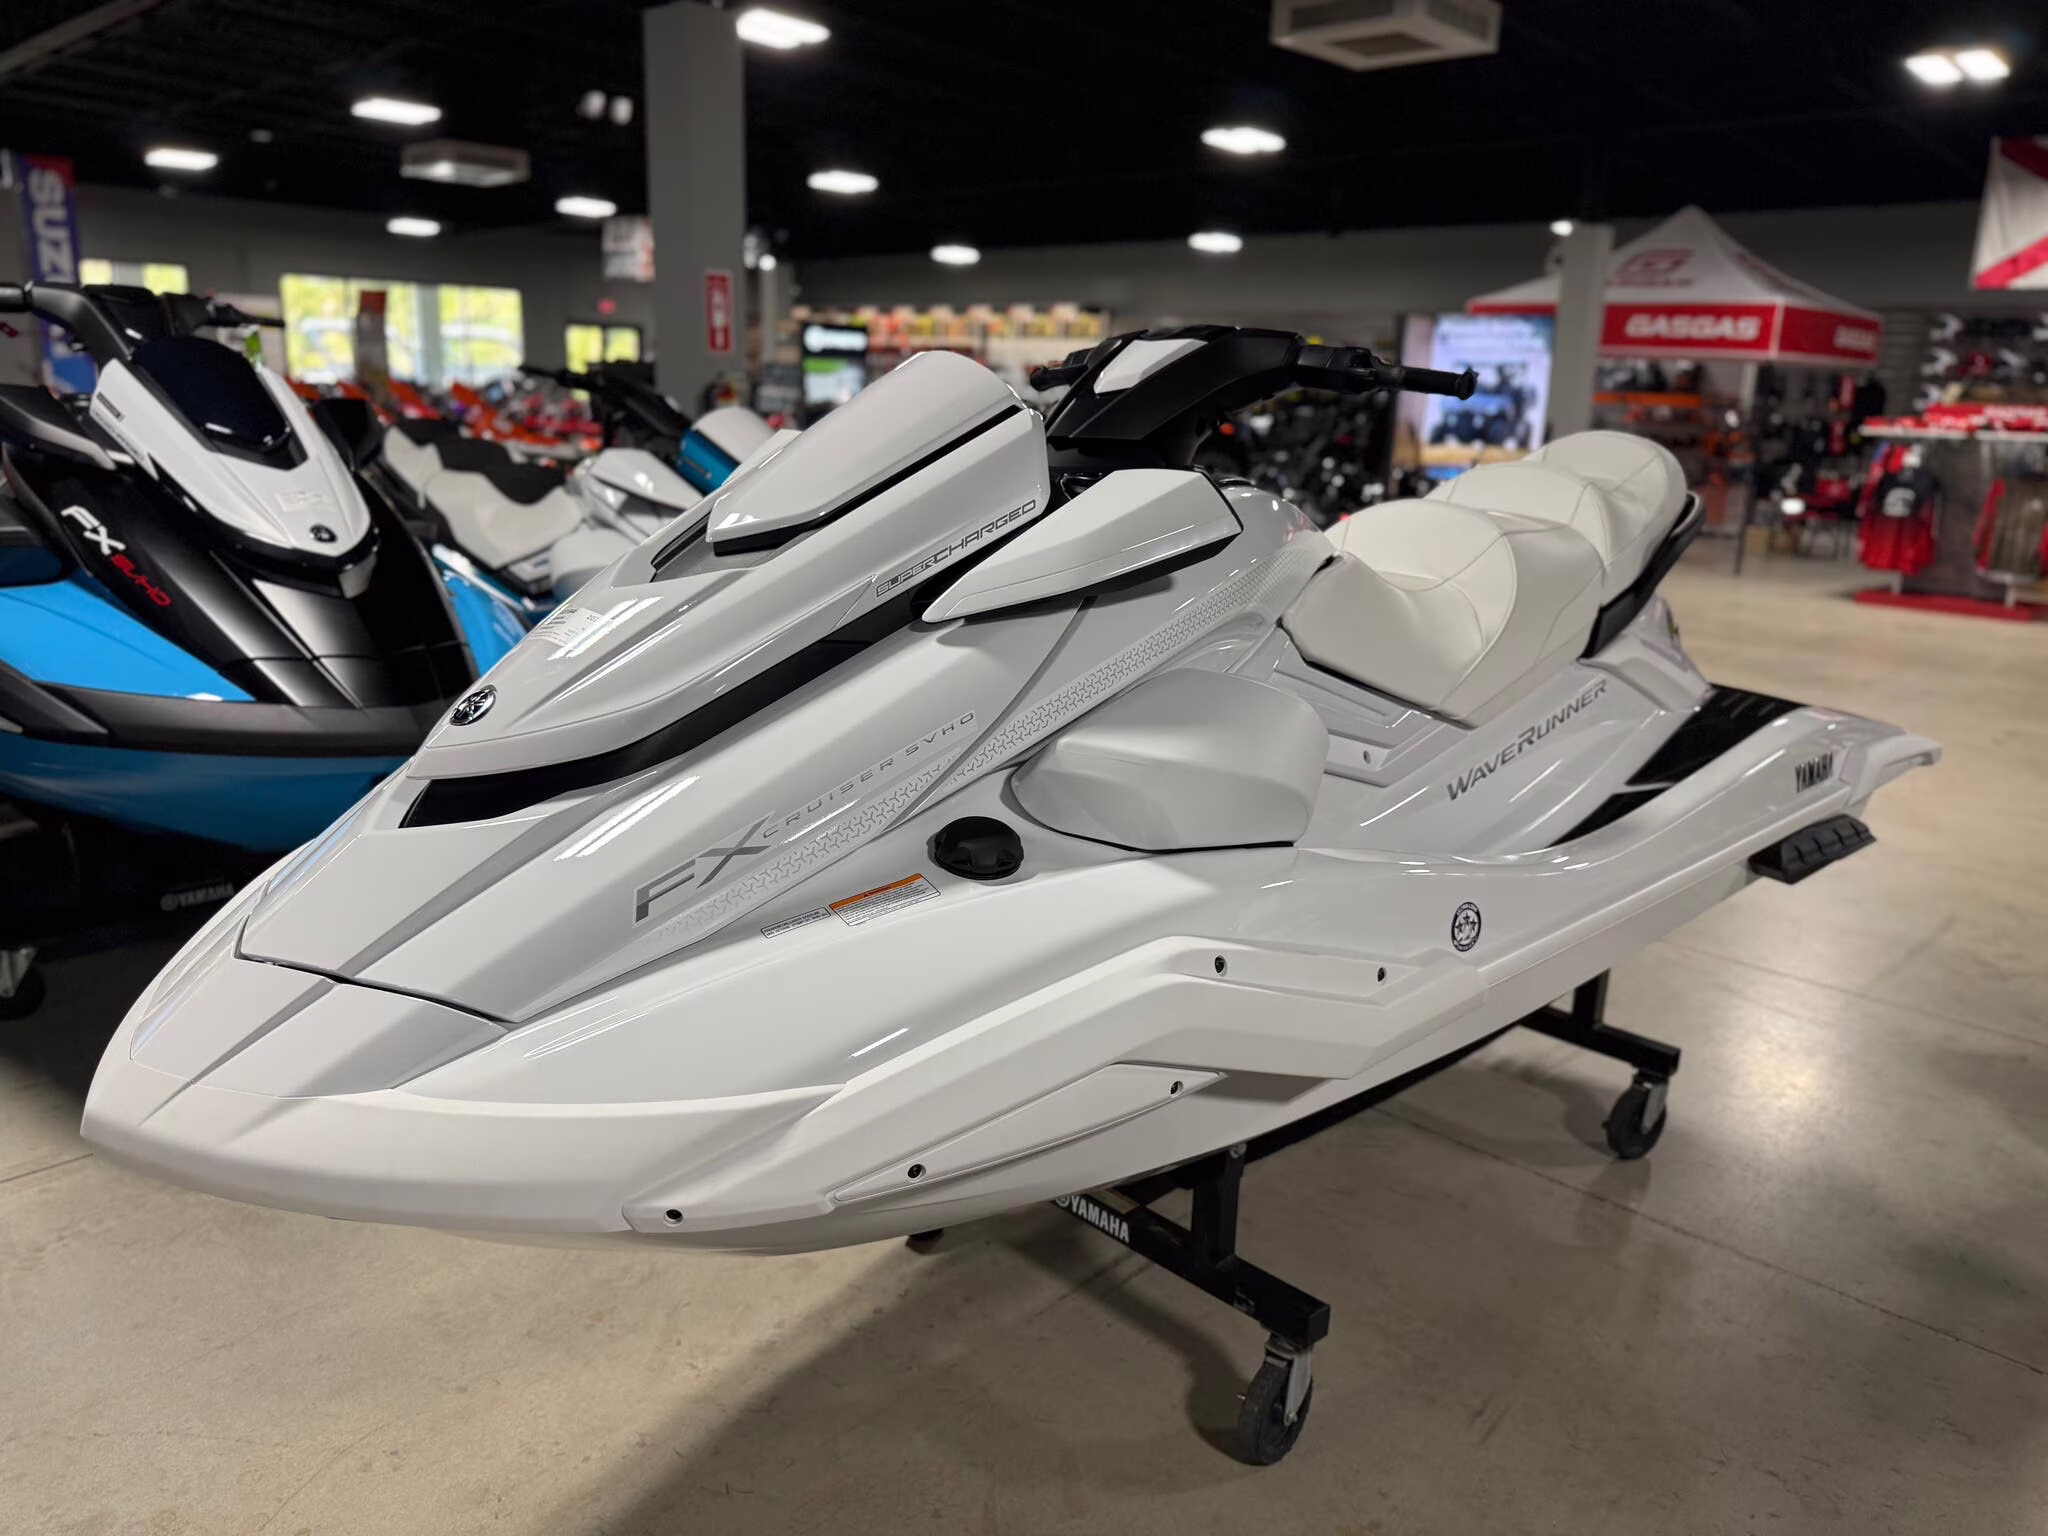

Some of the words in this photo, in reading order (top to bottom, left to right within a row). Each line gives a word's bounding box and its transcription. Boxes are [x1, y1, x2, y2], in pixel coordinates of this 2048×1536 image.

[28, 170, 75, 283] SUZ
[1624, 314, 1761, 341] GASGAS
[61, 505, 126, 555] FX
[876, 499, 1036, 597] SUPERCHARGED
[1795, 752, 1833, 792] YAMAHA
[635, 815, 772, 923] FX
[763, 757, 897, 839] CRUISER
[905, 712, 975, 757] SVHO
[1071, 1195, 1130, 1244] YAMAHA
